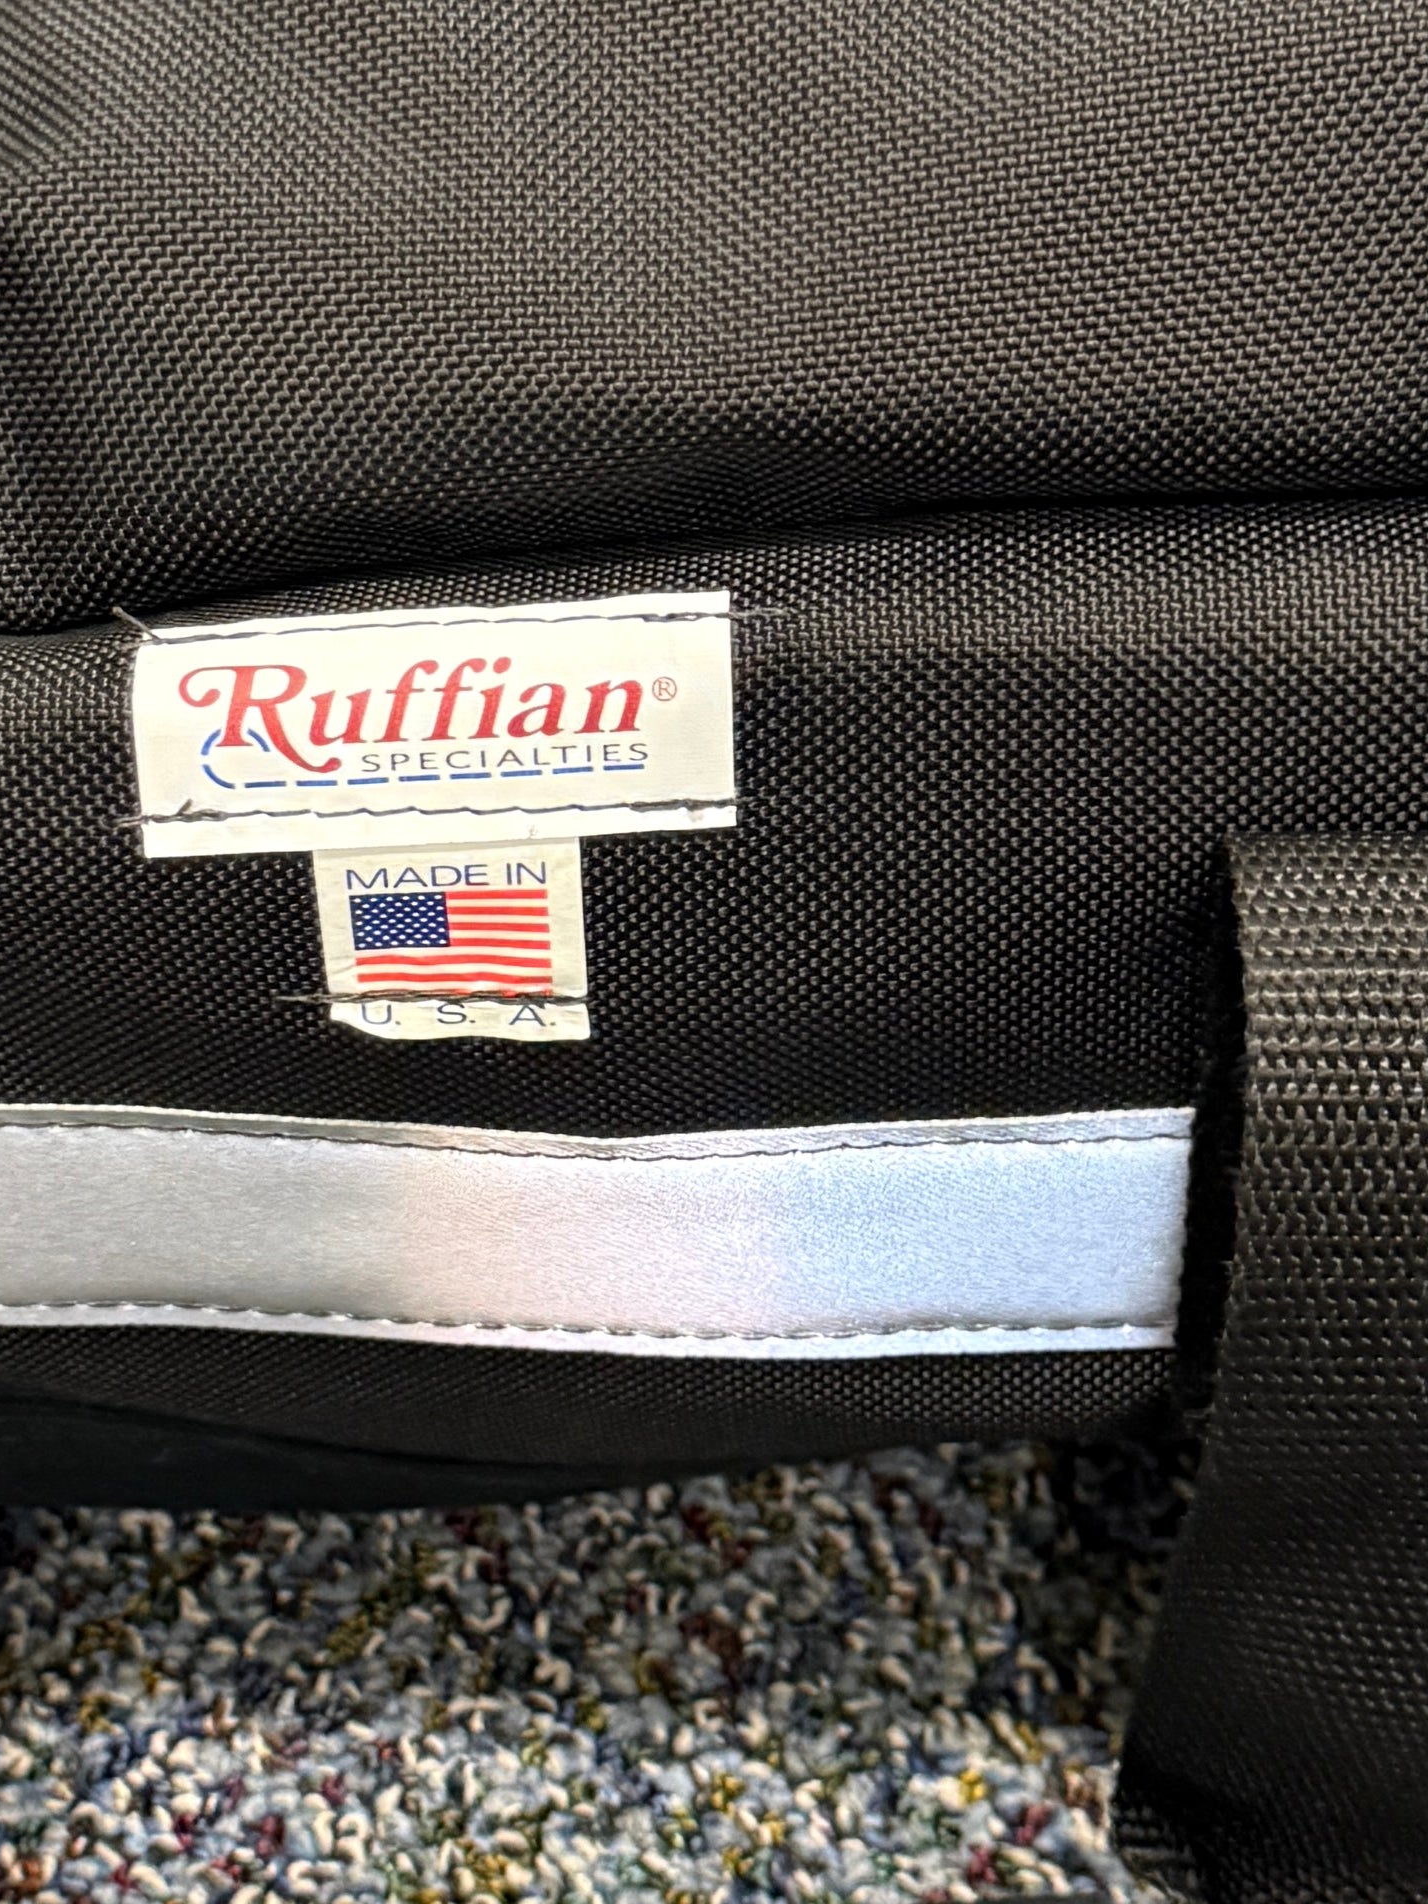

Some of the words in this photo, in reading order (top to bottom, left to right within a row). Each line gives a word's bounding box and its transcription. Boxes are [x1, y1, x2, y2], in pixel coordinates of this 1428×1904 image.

[361, 742, 649, 773] SPECIALTIES
[345, 863, 491, 890] MADE
[505, 861, 547, 886] IN
